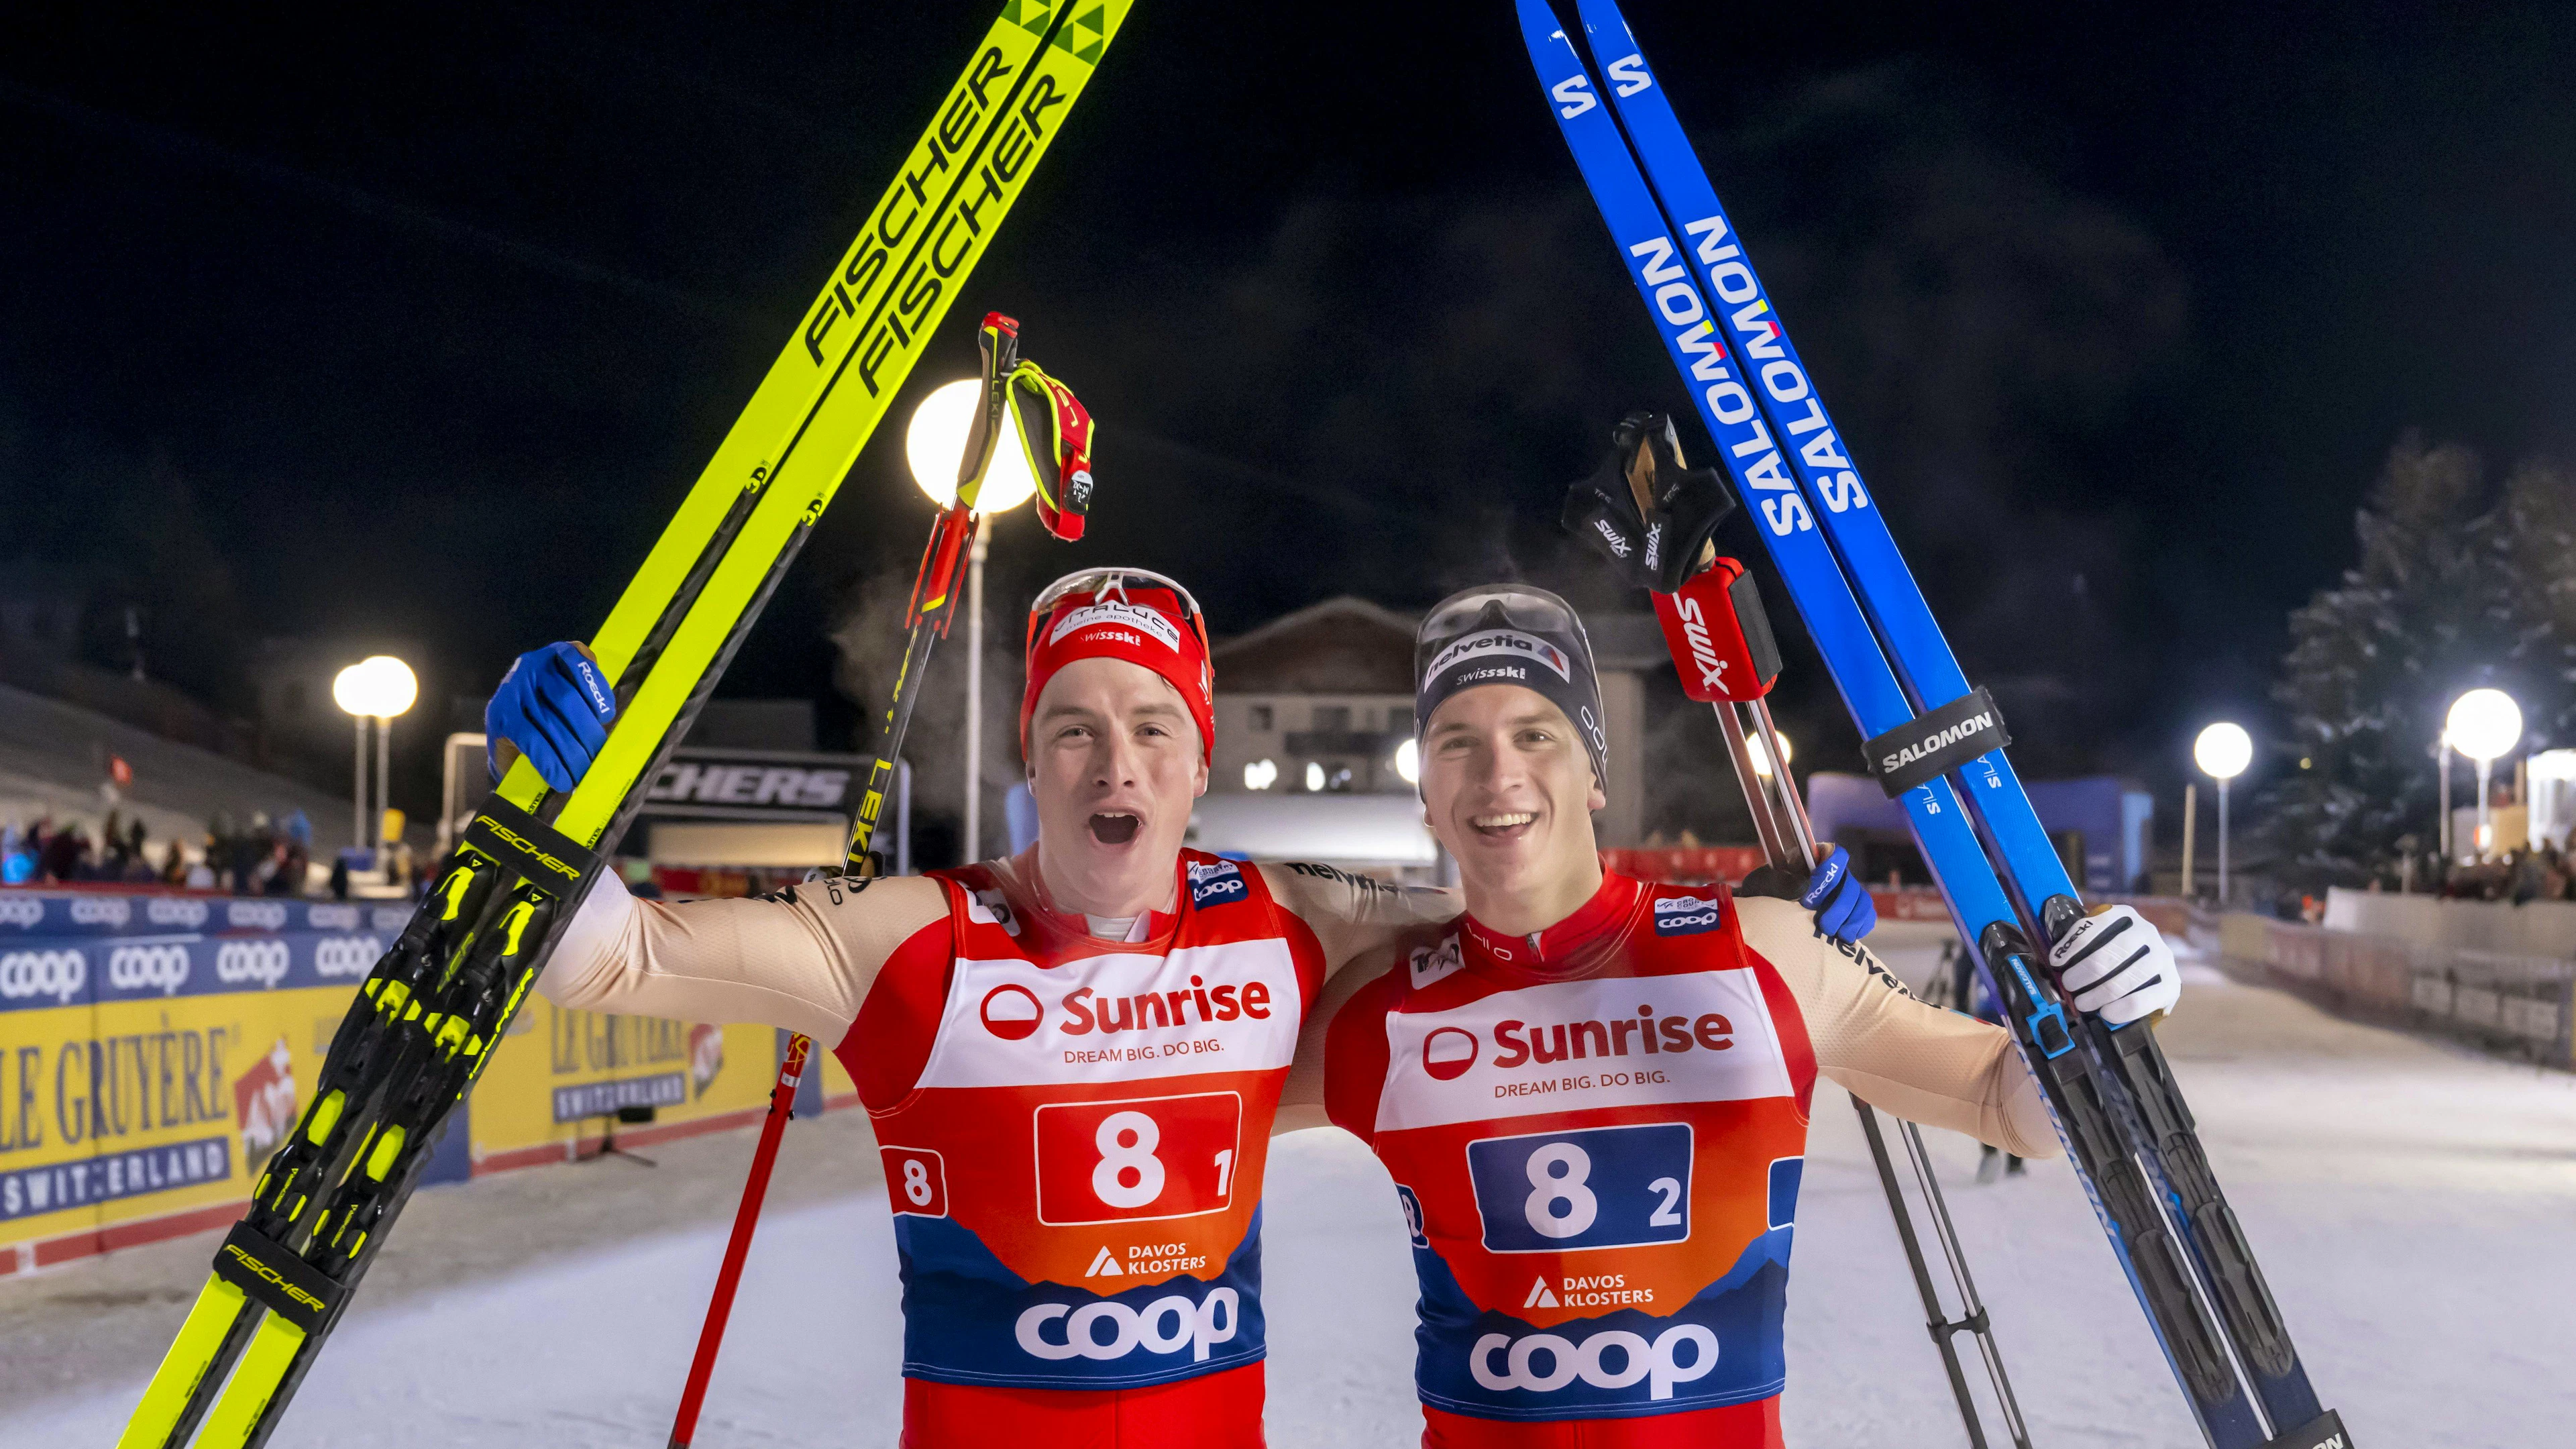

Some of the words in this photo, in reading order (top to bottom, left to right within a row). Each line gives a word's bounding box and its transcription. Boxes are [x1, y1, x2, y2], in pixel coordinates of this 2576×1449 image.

[1552, 74, 1597, 119] S
[1608, 53, 1652, 98] S
[804, 46, 1014, 368] FISCHER
[859, 73, 1067, 399] FISCHER
[1629, 235, 1813, 537] SALOMON
[1684, 215, 1868, 514] SALOMON
[991, 379, 1000, 419] LEKI
[1593, 519, 1632, 554] swix
[1646, 522, 1662, 570] swix
[1106, 611, 1163, 637] apotheke
[1672, 592, 1729, 695] swix
[1427, 635, 1532, 680] helvetia
[1456, 666, 1526, 686] swissski
[1882, 711, 1994, 774] SALOMON
[848, 758, 893, 864] LEKI
[475, 814, 581, 881] FISCHER
[1193, 880, 1243, 902] coop
[1658, 912, 1717, 928] coop
[2054, 920, 2094, 959] Roeckl
[0, 949, 87, 1005] coop
[109, 945, 190, 996] coop
[217, 941, 290, 989] coop
[2011, 957, 2037, 996] SALOMON
[1059, 974, 1271, 1035] Sunrise
[1063, 1049, 1122, 1064] DREAM
[1127, 1044, 1160, 1061] BIG.
[1164, 1040, 1189, 1057] DO
[1193, 1037, 1224, 1054] BIG.
[1492, 1004, 1734, 1069] Sunrise
[56, 1010, 229, 1146] GRUYÈRE
[1494, 1080, 1557, 1098] DREAM
[1562, 1075, 1597, 1092] BIG.
[1601, 1072, 1629, 1087] DO
[1634, 1071, 1670, 1085] BIG.
[3, 1142, 225, 1214] SWITZERLAND
[903, 1159, 932, 1206] 8
[1091, 1111, 1166, 1209] 8
[1214, 1149, 1232, 1196] 1
[1525, 1142, 1598, 1238] 8
[1647, 1177, 1682, 1227] 2
[1128, 1242, 1186, 1259] DAVOS
[1128, 1255, 1206, 1275] KLOSTERS
[223, 1244, 326, 1313] FISCHER
[1564, 1274, 1625, 1291] DAVOS
[1564, 1289, 1654, 1307] KLOSTERS
[1015, 1287, 1239, 1362] coop
[1469, 1324, 1719, 1401] coop
